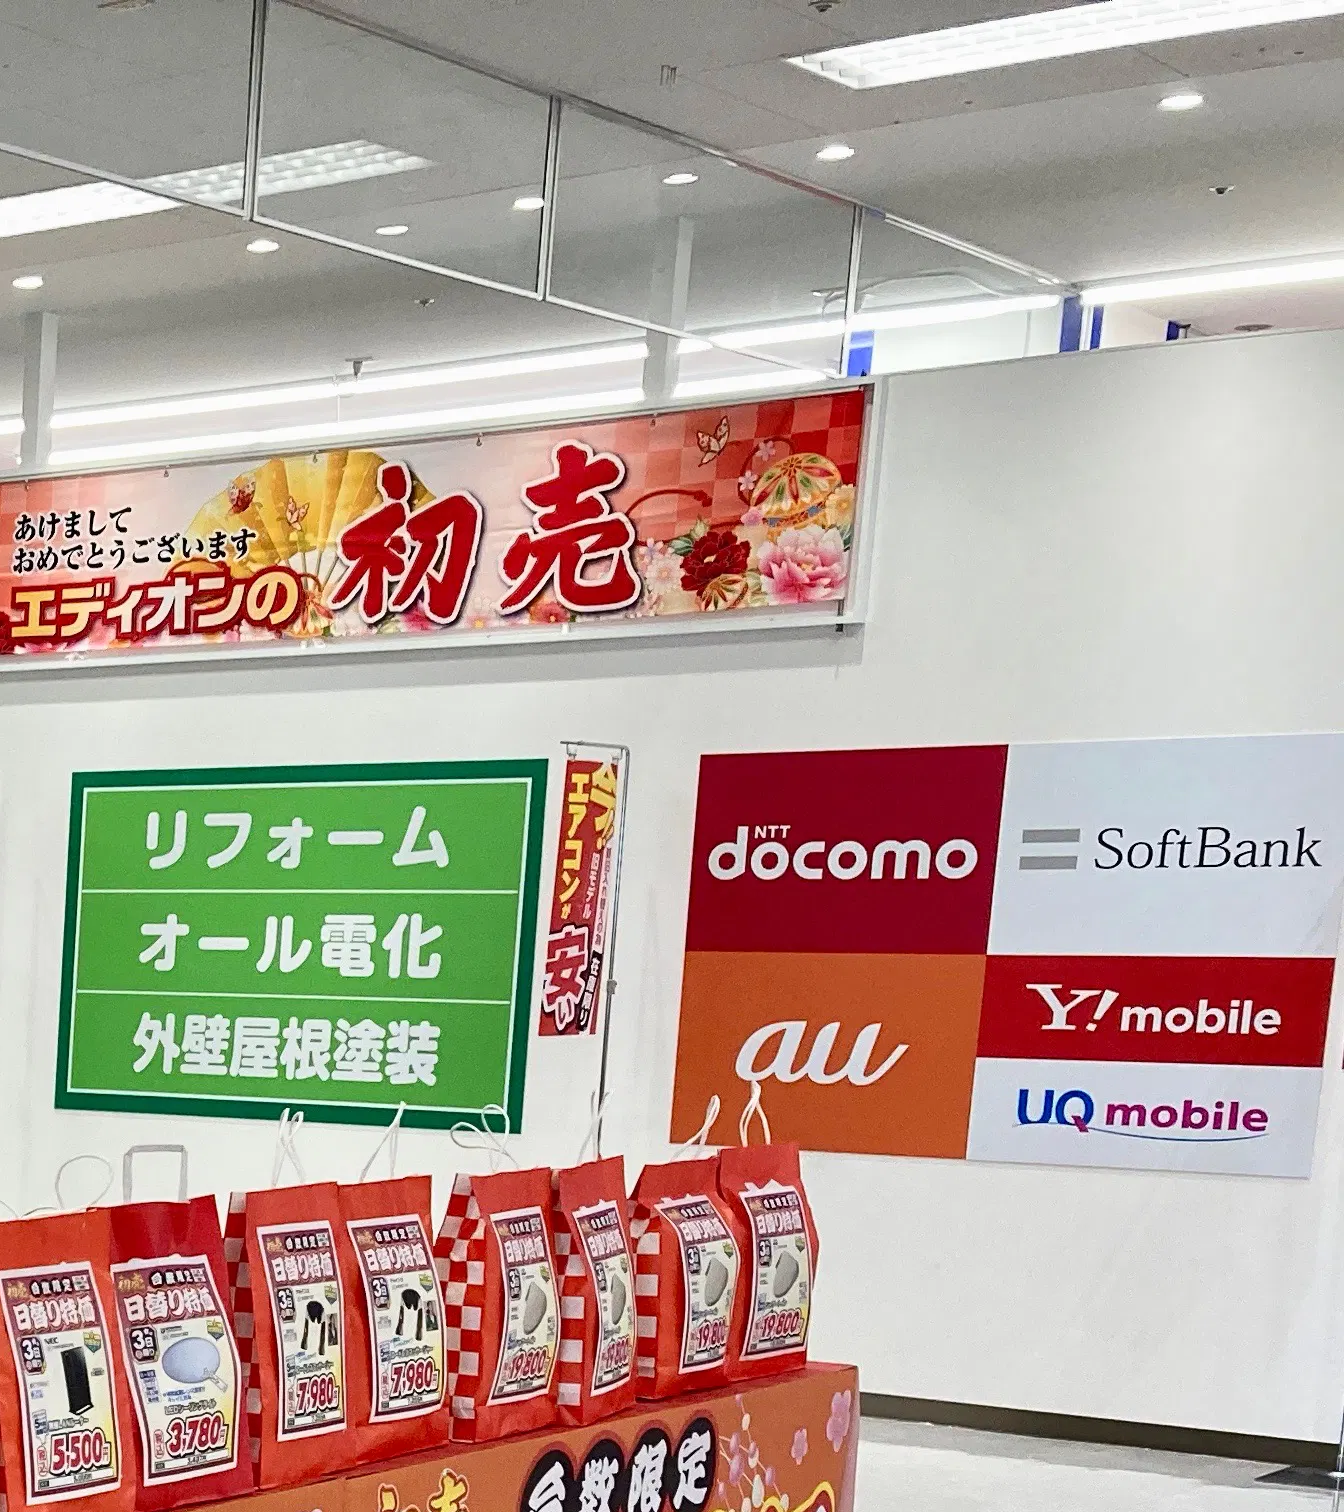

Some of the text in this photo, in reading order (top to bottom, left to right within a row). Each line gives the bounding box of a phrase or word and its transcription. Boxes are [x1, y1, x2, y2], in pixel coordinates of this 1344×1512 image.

[13, 503, 136, 546] あけまして
[330, 438, 647, 627] 初売
[11, 526, 258, 574] おめでとうございます
[10, 564, 304, 643] エディオンの
[143, 807, 451, 872] リフォーム
[560, 773, 590, 919] エアコンが
[708, 825, 978, 880] docomo
[753, 825, 791, 838] NTT
[1093, 825, 1323, 872] SoftBank
[138, 913, 443, 980] オール電化
[543, 924, 589, 1031] 安い
[1120, 999, 1282, 1035] mobile
[132, 1011, 440, 1088] 外壁屋根塗装
[735, 1020, 910, 1086] au
[1016, 1088, 1269, 1133] UQ mobile
[13, 1295, 96, 1331] 日替り特価
[123, 1287, 216, 1321] 日替り特価
[296, 1374, 339, 1415] 7,980円
[390, 1356, 439, 1397] 7,980円
[52, 1430, 111, 1473] 5,500円
[167, 1414, 228, 1456] 3,780円
